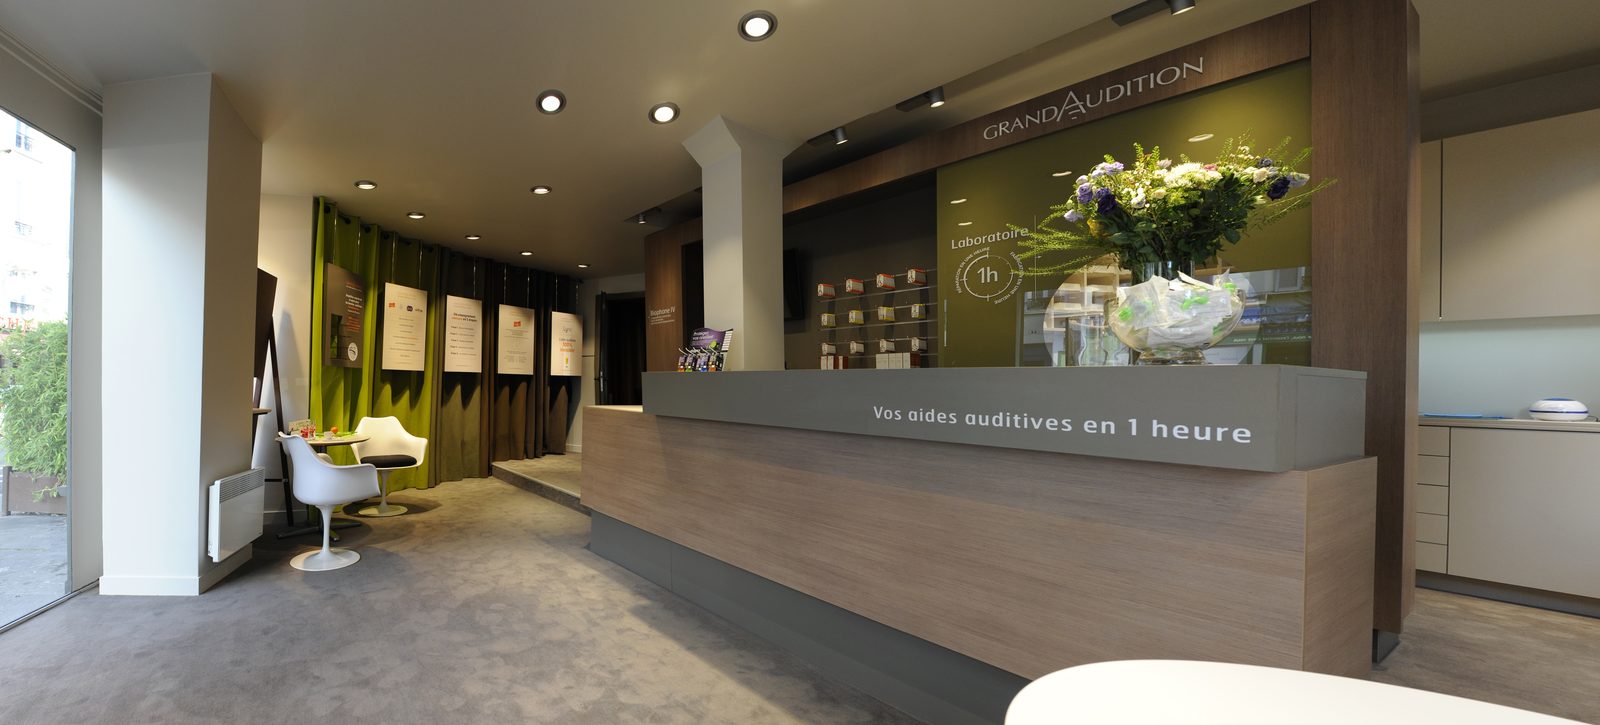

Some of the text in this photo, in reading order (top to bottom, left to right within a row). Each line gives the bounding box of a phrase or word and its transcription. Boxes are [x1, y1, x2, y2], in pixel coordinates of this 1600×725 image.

[951, 227, 1029, 250] Laboratoire
[977, 266, 999, 284] 1h
[873, 406, 1252, 444] Vos aides auditives en 1 heure
